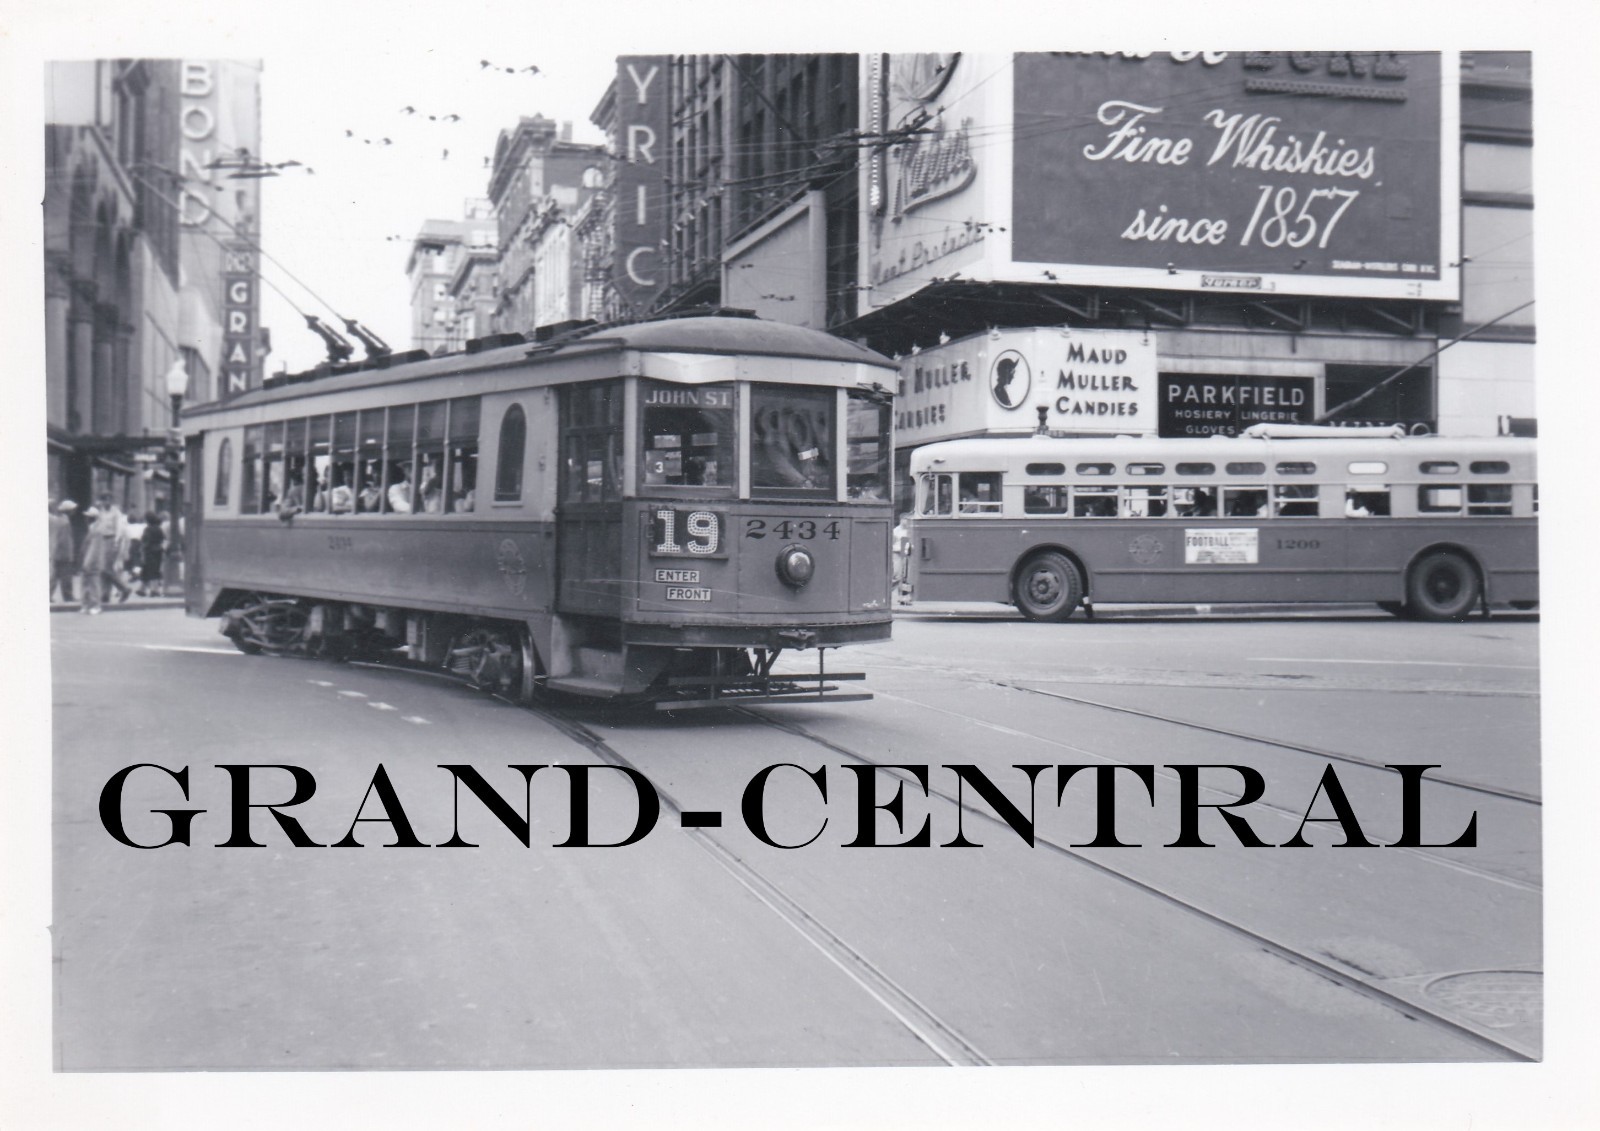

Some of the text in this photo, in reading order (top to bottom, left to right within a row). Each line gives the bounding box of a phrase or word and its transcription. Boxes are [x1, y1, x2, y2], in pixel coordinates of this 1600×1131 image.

[180, 59, 214, 226] BOND
[1083, 99, 1193, 166] Fine
[626, 63, 660, 287] YRIC
[1121, 184, 1361, 249] since 1857
[1066, 343, 1128, 365] MAUD
[1057, 369, 1139, 392] MULLER
[645, 390, 731, 406] JOHN ST
[1055, 396, 1140, 416] CANDIES
[1167, 384, 1306, 407] PARKFIELD
[1174, 409, 1299, 421] HOSIERY LINGERIE
[1185, 423, 1236, 436] GLOVES
[656, 510, 719, 555] 19
[745, 519, 842, 540] 2434
[657, 570, 698, 581] ENTER
[668, 588, 710, 600] FRONT
